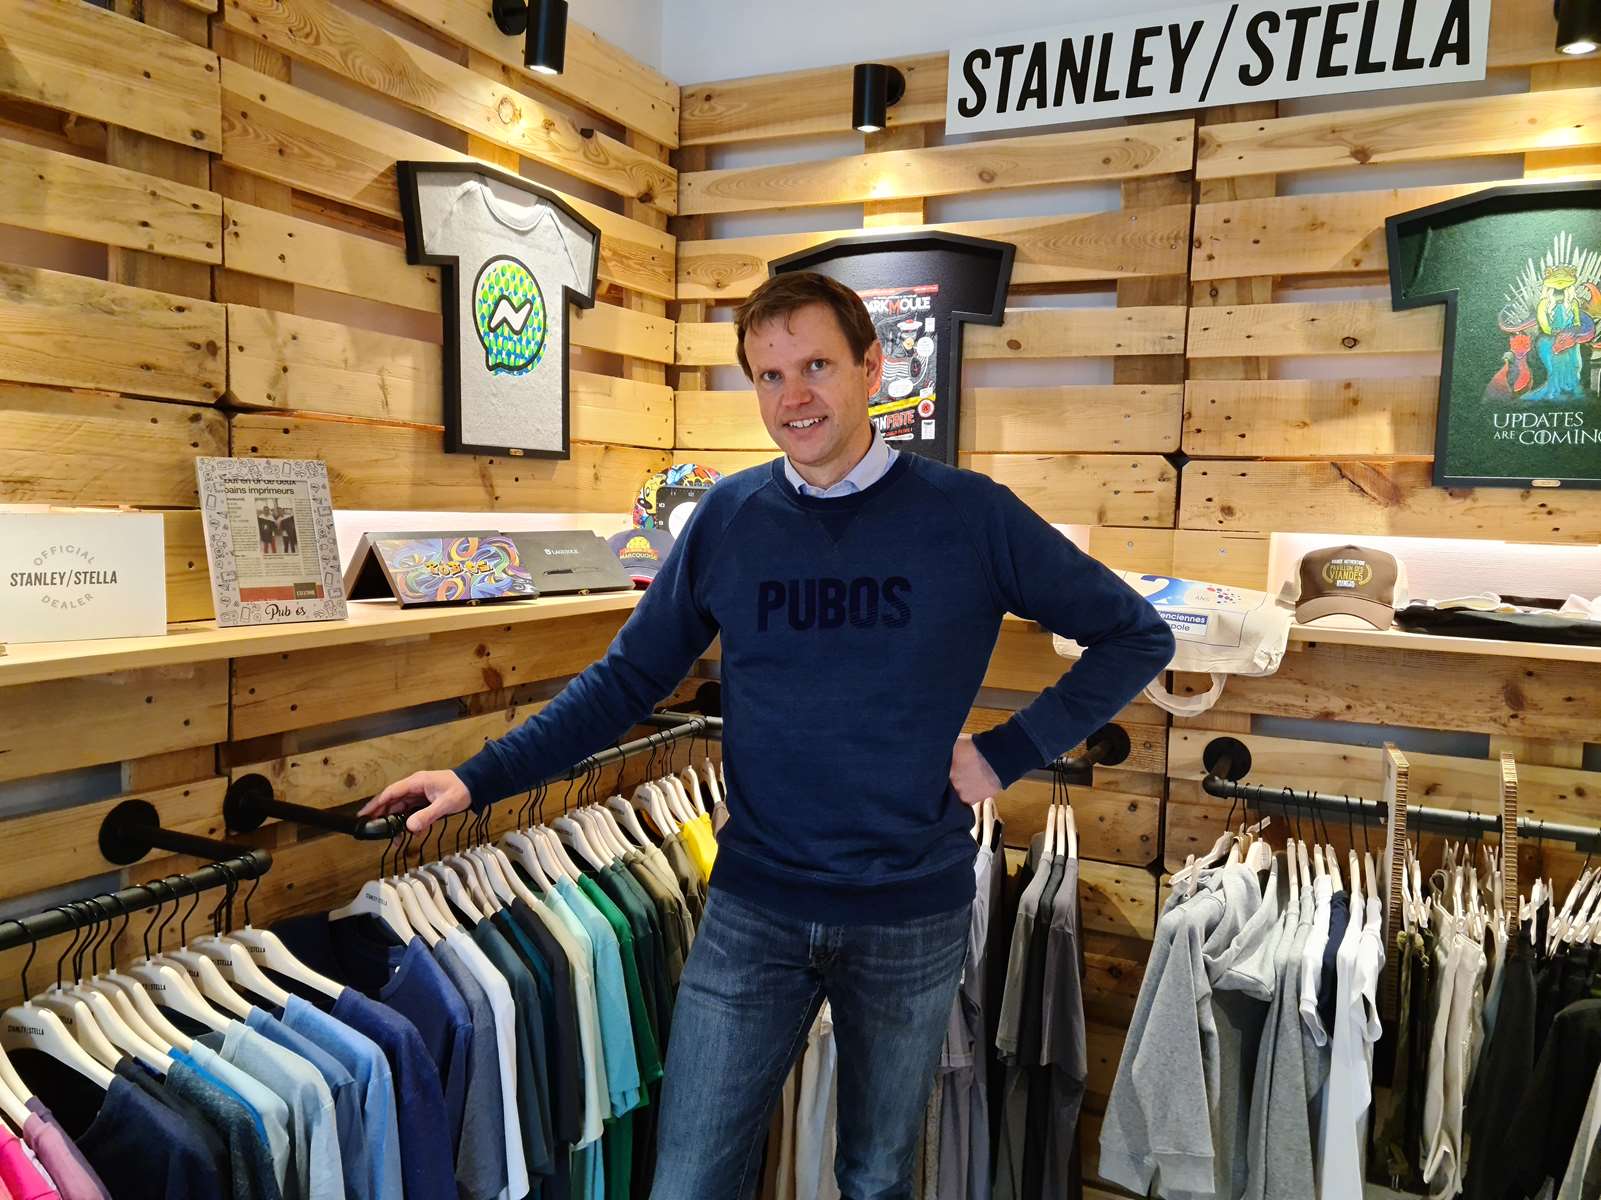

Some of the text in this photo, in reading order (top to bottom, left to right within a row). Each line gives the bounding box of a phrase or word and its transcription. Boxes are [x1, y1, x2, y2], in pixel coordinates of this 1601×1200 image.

[957, 0, 1471, 118] STANLEY/STELLA
[1493, 411, 1584, 428] UPDATES
[1493, 428, 1601, 445] ARE COMIN
[248, 486, 295, 496] imprimeurs
[33, 544, 96, 567] OFFICIAL
[10, 569, 118, 588] STANLEY/STELLA
[41, 592, 94, 609] DEALER
[757, 576, 913, 632] PUBOS
[265, 603, 291, 620] Pub
